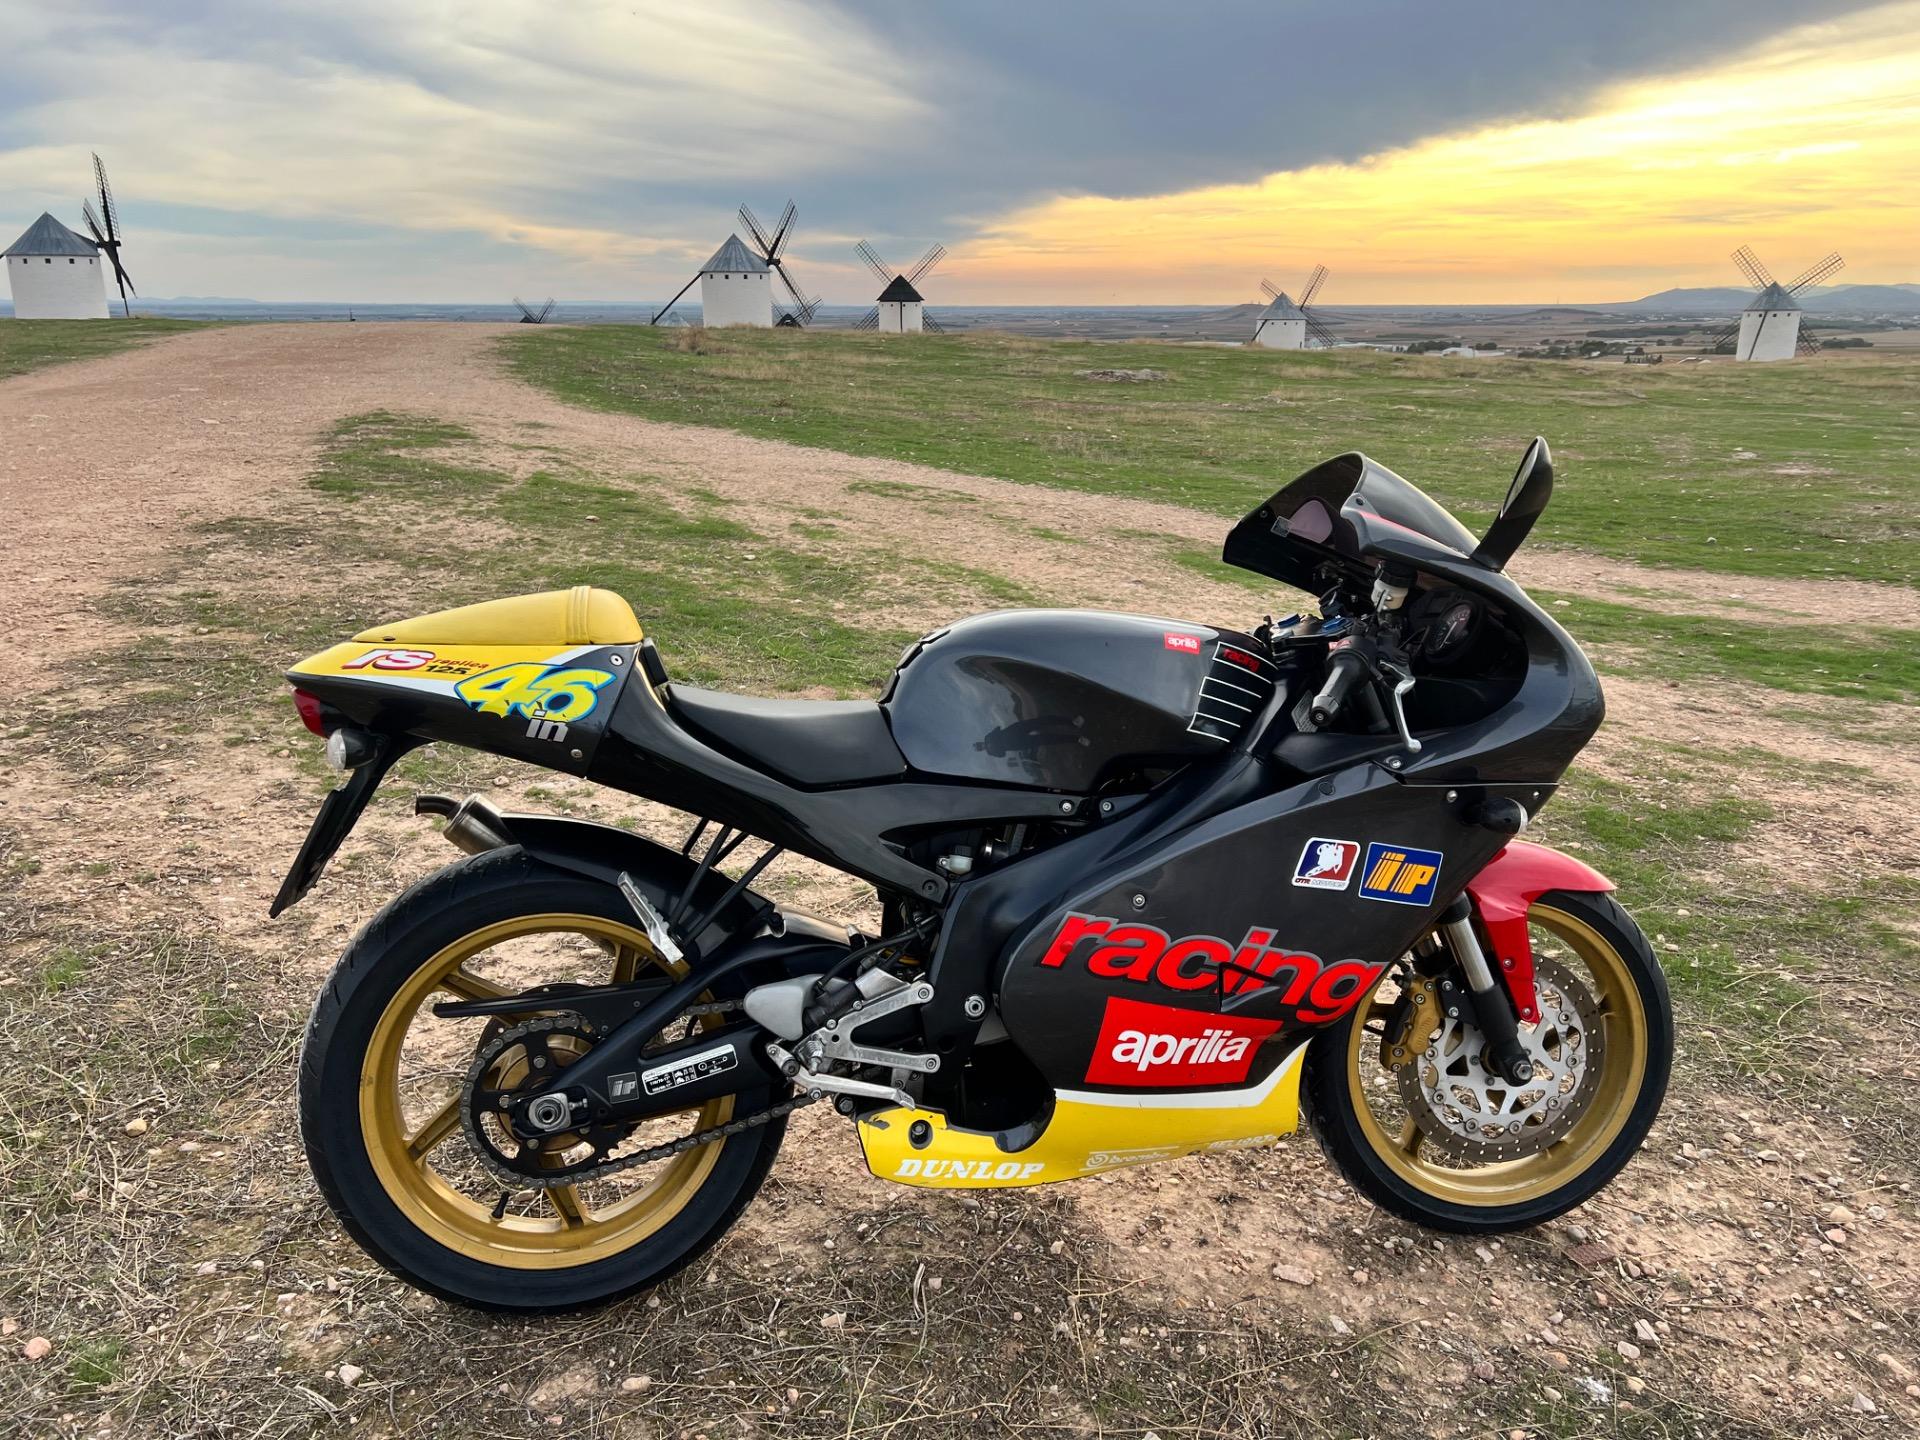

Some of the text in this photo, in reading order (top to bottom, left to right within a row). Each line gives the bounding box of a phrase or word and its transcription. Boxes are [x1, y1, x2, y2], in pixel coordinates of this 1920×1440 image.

[1167, 636, 1198, 649] aprilia
[425, 664, 471, 675] 125
[1222, 648, 1260, 673] racing
[454, 662, 617, 722] 46
[1037, 911, 1389, 1023] racing
[1111, 1029, 1252, 1072] aprilia
[894, 1158, 1045, 1181] DUNLOP
